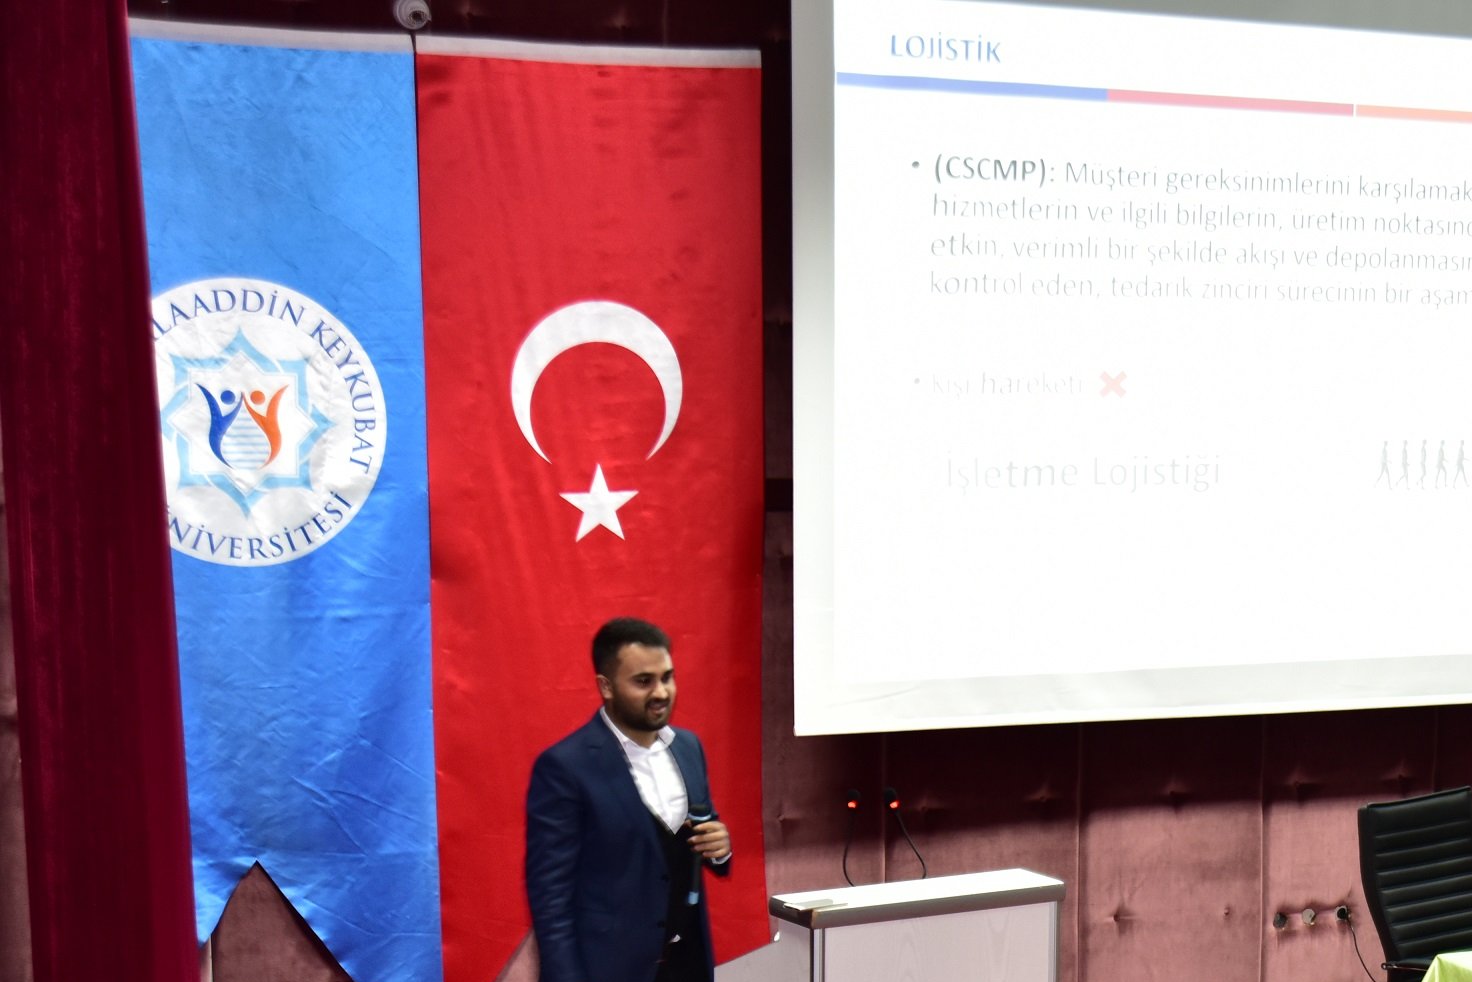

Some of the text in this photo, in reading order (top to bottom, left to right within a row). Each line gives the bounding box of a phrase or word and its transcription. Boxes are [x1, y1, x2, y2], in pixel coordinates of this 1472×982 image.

[891, 31, 1001, 63] LOJİSTİK
[934, 153, 1056, 188] (CSCMP):
[1065, 160, 1157, 191] Müşteri
[1166, 167, 1351, 198] gereksinimlerini
[1359, 175, 1472, 204] karşılamak
[933, 193, 1078, 221] hizmetlerin
[1087, 205, 1113, 222] ve
[1122, 200, 1167, 230] ilgili
[1292, 208, 1365, 232] üretim
[1013, 236, 1099, 260] verimli
[1147, 240, 1227, 268] şekilde
[1235, 244, 1285, 270] akışı
[1293, 249, 1318, 268] ve
[929, 271, 1022, 296] kontrol
[1111, 275, 1192, 298] tedarik
[1276, 279, 1377, 303] sürecinin
[152, 289, 377, 475] LAADDİN KEYKUBAT
[1094, 454, 1222, 493] Lojistiği
[167, 490, 352, 560] NİVERSİTESİ
